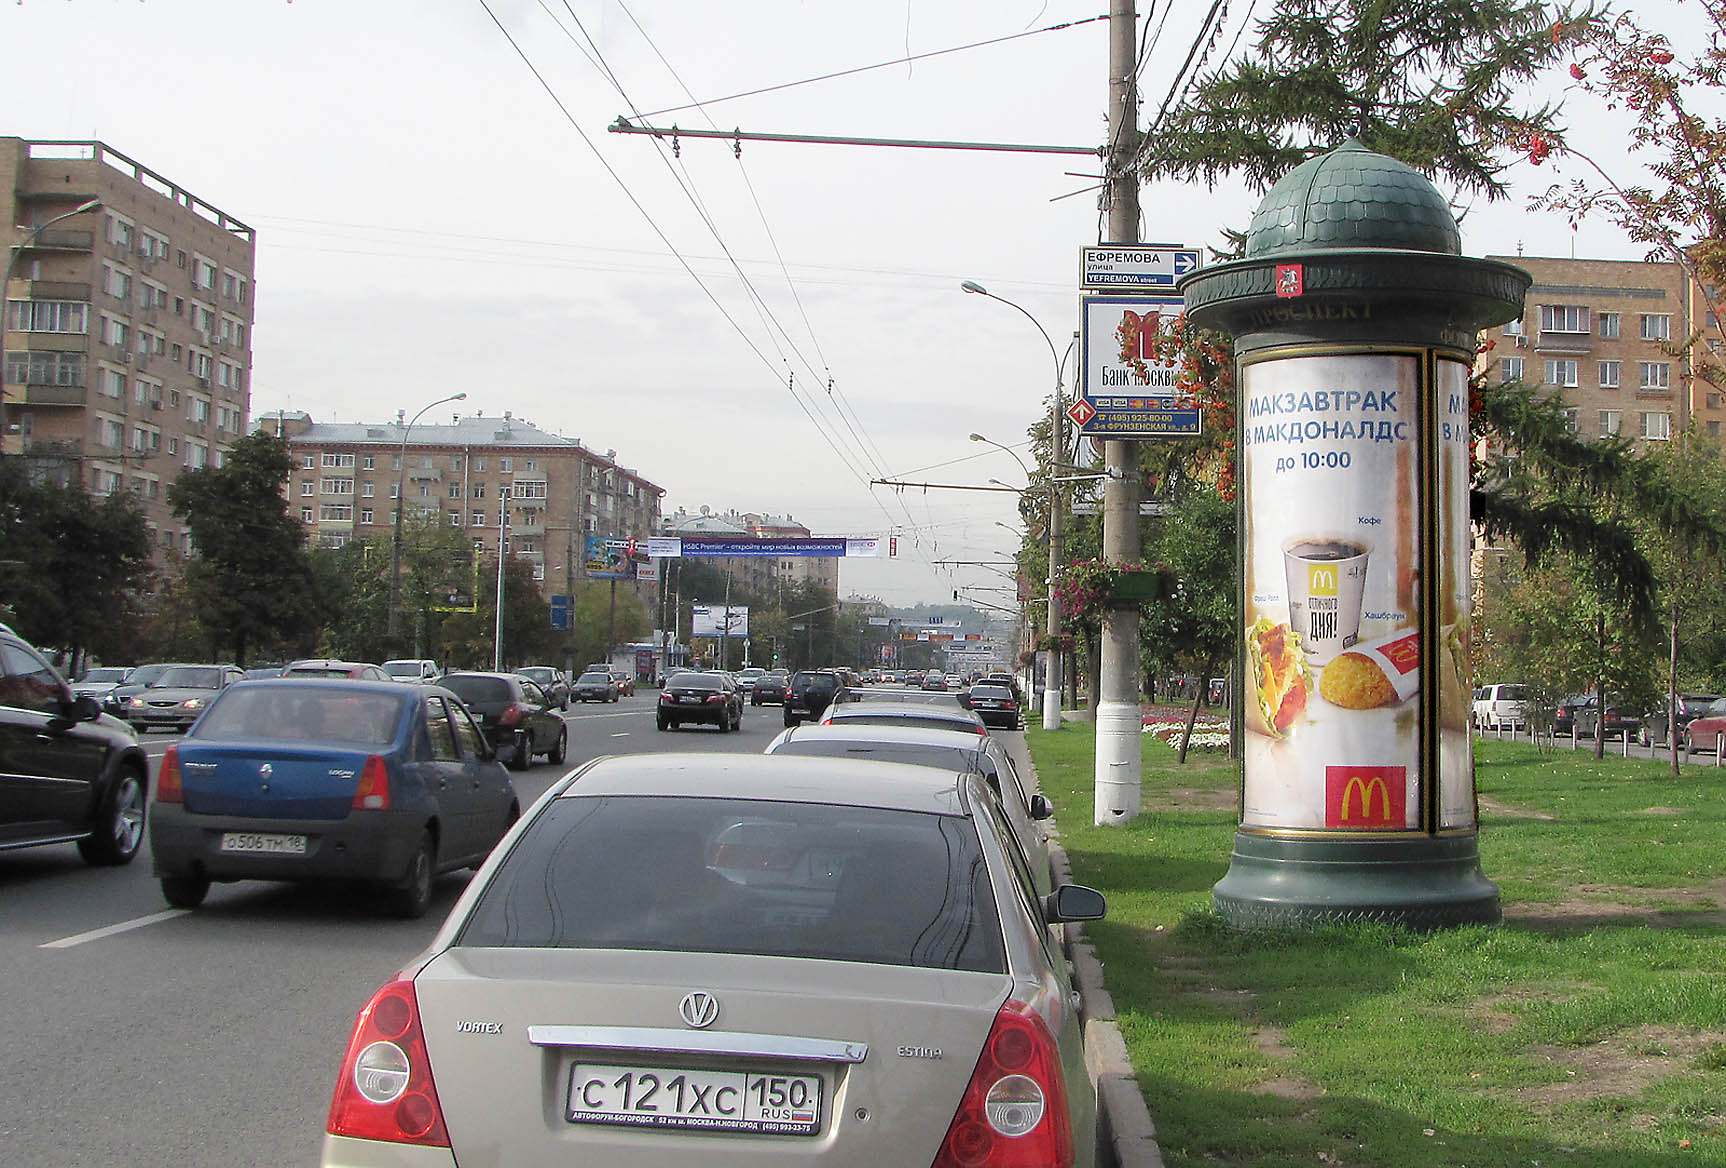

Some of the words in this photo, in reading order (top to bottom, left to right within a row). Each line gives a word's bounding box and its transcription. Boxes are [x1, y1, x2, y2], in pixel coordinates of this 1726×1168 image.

[1087, 252, 1160, 263] ЕФРЕМОВА
[1088, 274, 1139, 283] YEFREMOVA
[1102, 365, 1129, 386] Банк
[1249, 391, 1397, 417] МАКЗАВТРАК
[1108, 414, 1129, 422] (495)
[1132, 414, 1172, 422] 925-80-00
[1107, 422, 1167, 430] ФРУНЗЕНСКАЯ
[1443, 422, 1451, 440] В
[1246, 428, 1251, 446] В
[1254, 420, 1408, 443] МАКДОНАЛДС
[1276, 456, 1295, 473] до
[1301, 452, 1351, 468] 10:00
[1358, 516, 1381, 525] Кофе
[797, 543, 842, 551] возможностей
[1310, 611, 1337, 641] ДНЯ!
[456, 1021, 504, 1034] VORTEX
[751, 1077, 807, 1107] 150
[573, 1111, 653, 1124] АВТОФОРУМ-БОГОРОДСК
[762, 1108, 791, 1120] RUS
